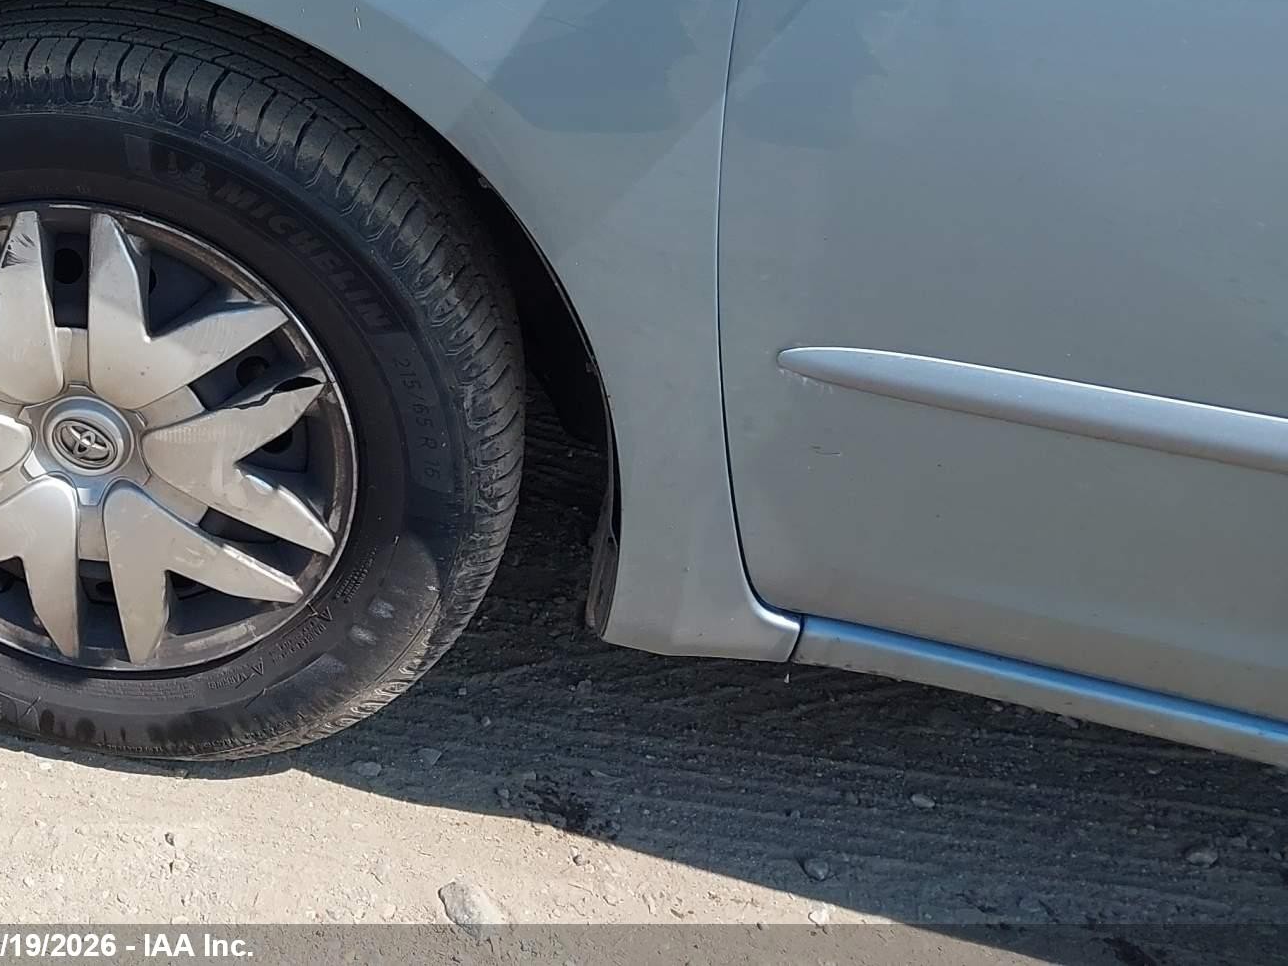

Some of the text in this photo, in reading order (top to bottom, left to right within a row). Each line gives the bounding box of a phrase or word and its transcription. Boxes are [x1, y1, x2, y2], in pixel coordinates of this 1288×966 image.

[213, 183, 394, 328] MICHELIN
[393, 356, 441, 479] 215/65 R 16
